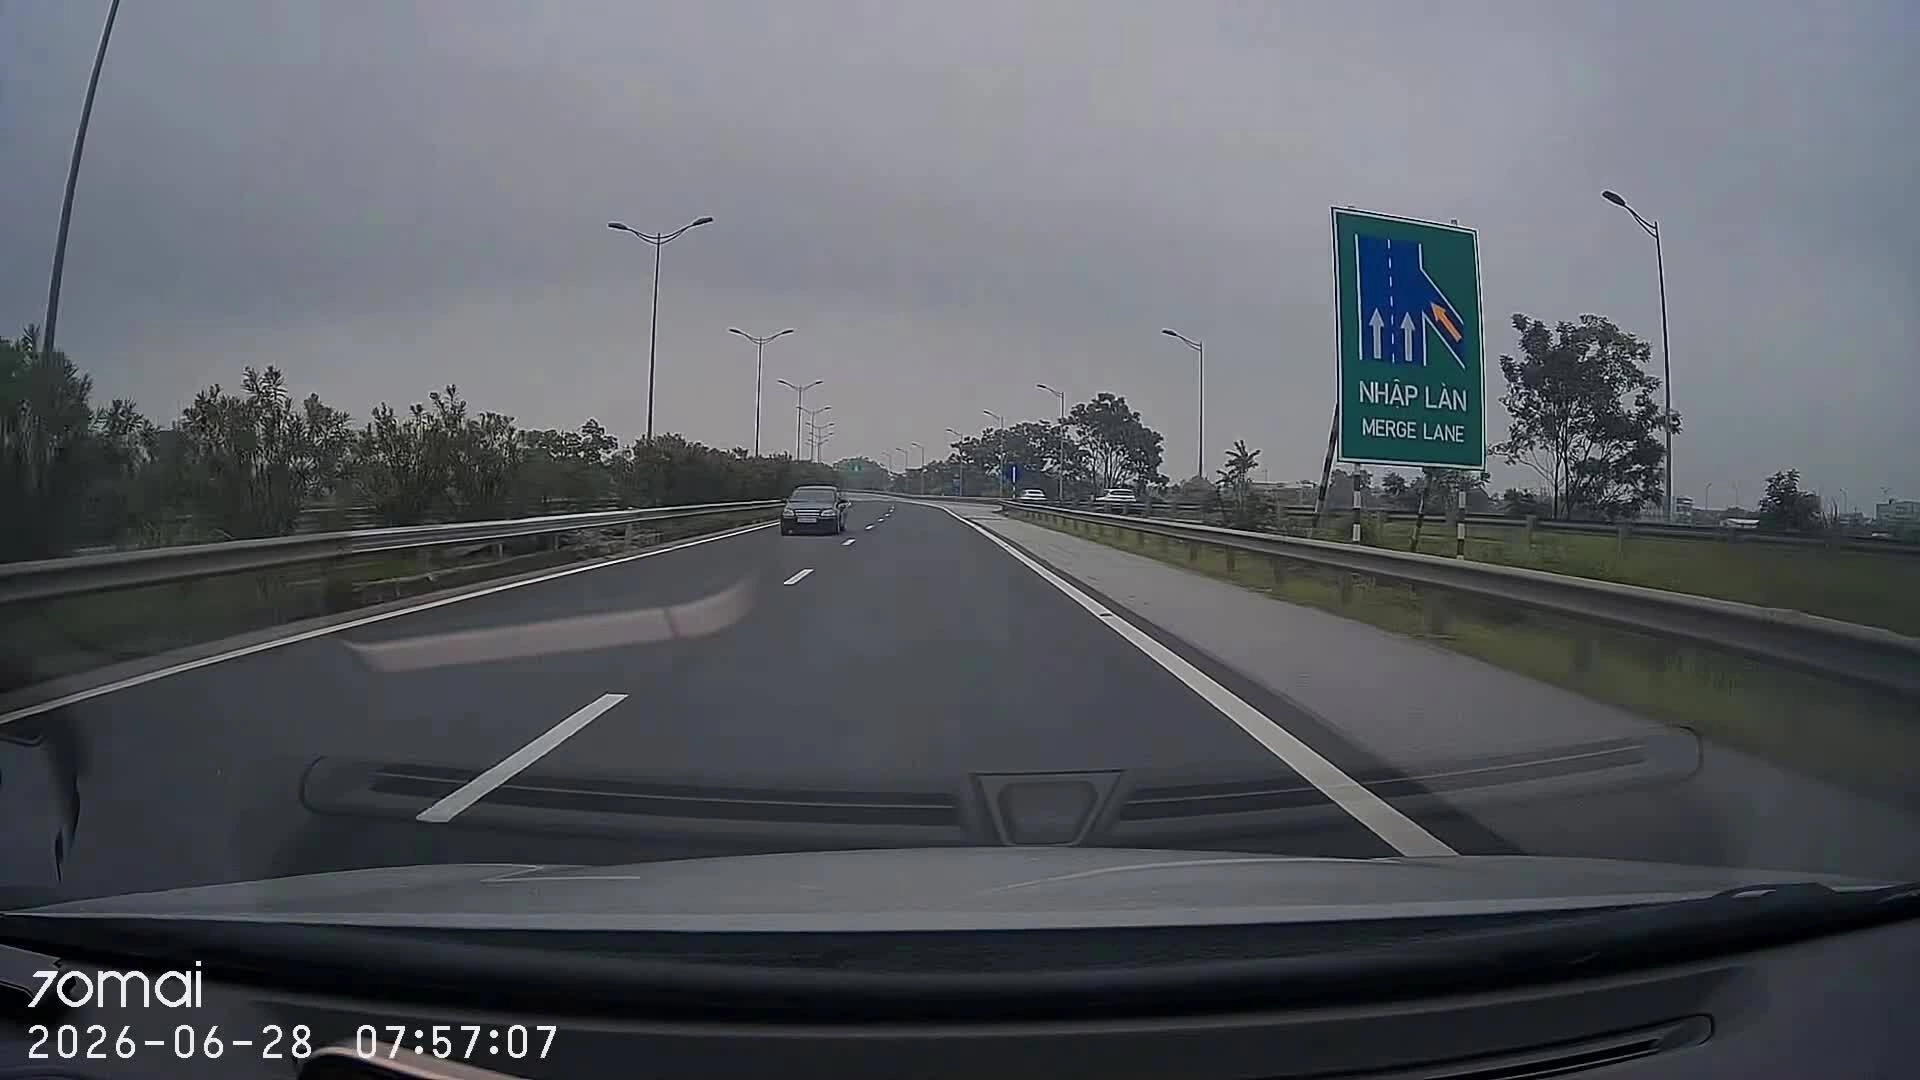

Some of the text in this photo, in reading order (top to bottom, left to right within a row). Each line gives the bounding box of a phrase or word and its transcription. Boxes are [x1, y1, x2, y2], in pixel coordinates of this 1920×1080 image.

[1359, 378, 1467, 412] NHẬP LÀN
[1362, 417, 1465, 443] MERGE LANE
